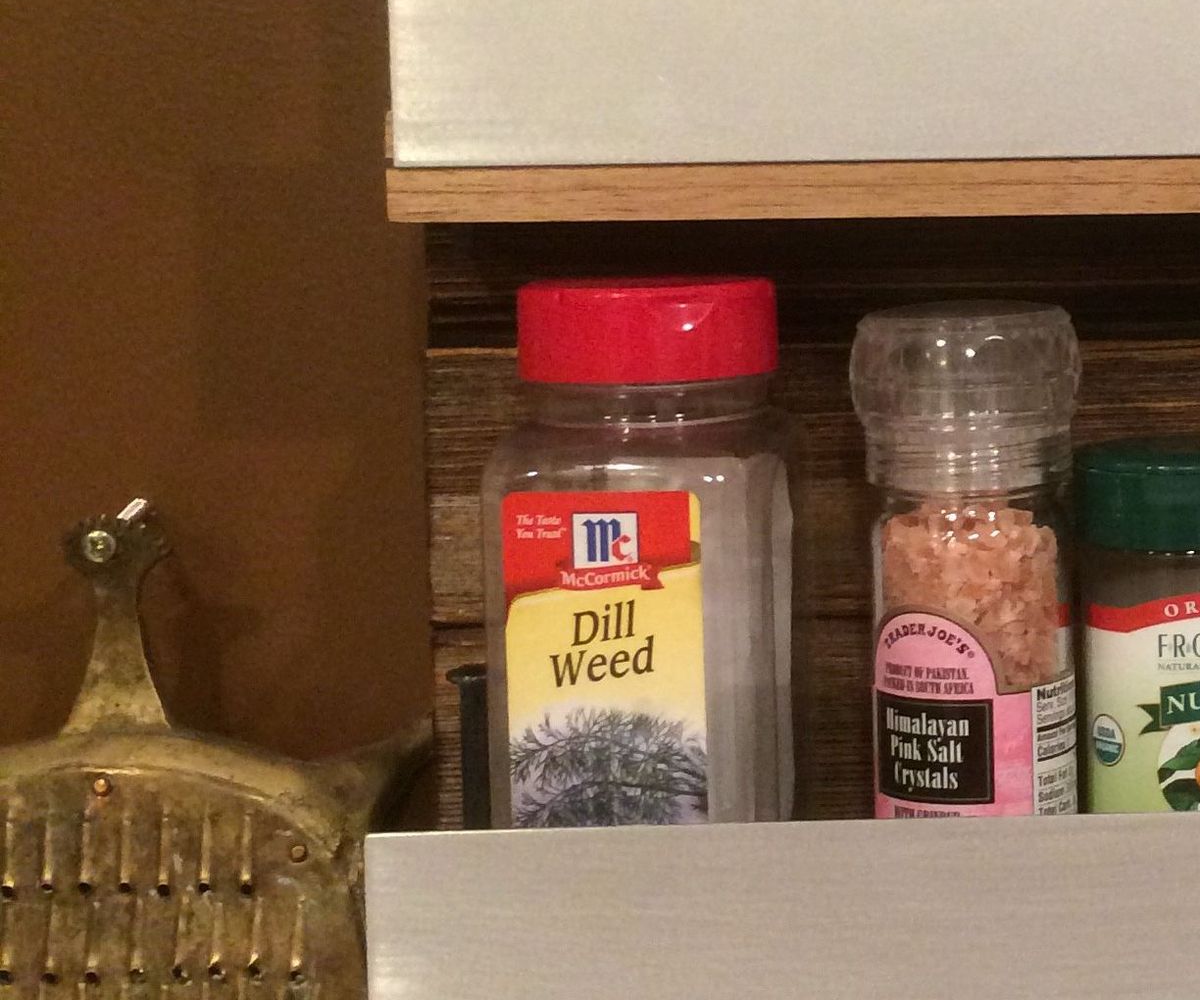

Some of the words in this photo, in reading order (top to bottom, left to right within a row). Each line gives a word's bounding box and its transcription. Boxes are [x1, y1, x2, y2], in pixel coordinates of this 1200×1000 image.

[515, 528, 534, 539] You
[516, 514, 534, 525] The
[535, 514, 562, 525] Taste
[559, 566, 649, 587] McCormick
[571, 600, 635, 646] Dill
[885, 623, 927, 649] TRADER
[927, 625, 971, 655] JOE'S
[550, 636, 654, 687] Weed
[886, 707, 969, 737] Himalayan
[890, 734, 921, 761] Pink
[927, 735, 964, 763] Salt
[894, 761, 959, 792] Crystals
[1038, 774, 1057, 786] Total
